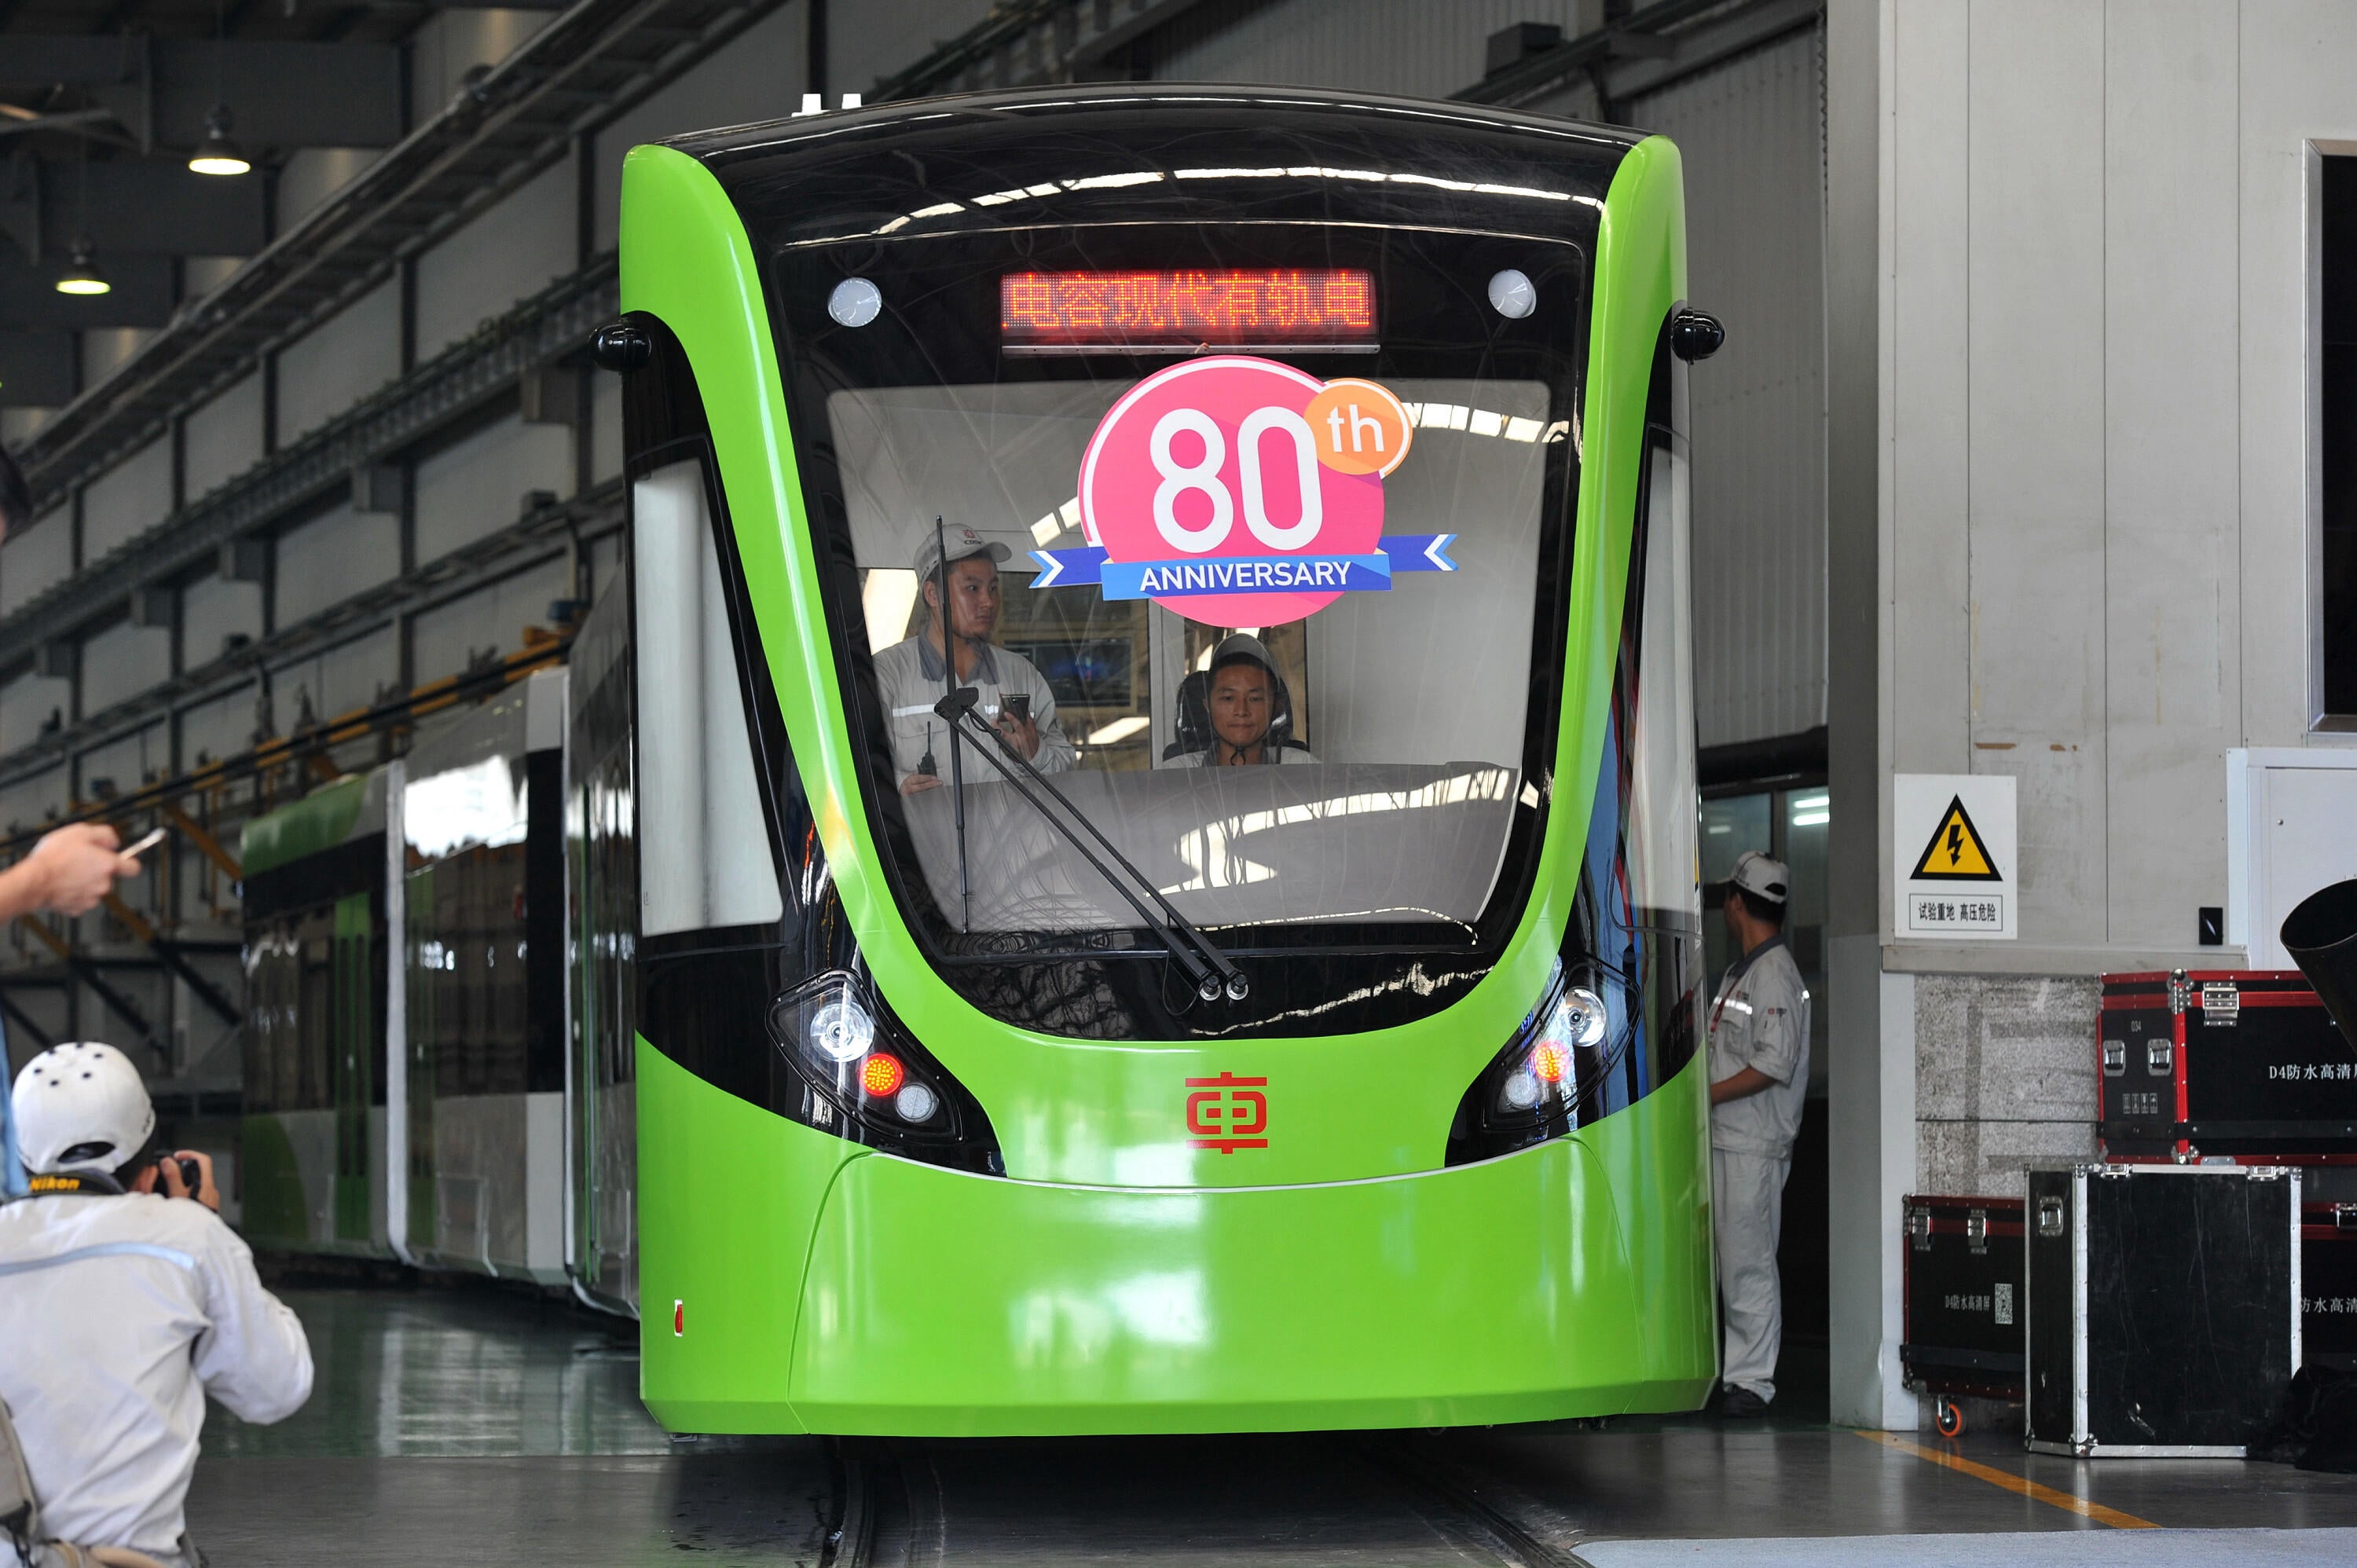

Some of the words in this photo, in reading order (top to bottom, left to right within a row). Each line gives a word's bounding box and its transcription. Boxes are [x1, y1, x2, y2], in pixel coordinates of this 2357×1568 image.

[1010, 273, 1369, 328] 电容现代有轨电
[1149, 405, 1323, 554] 80
[1326, 404, 1385, 453] th
[1139, 561, 1351, 592] ANNIVERSARY
[1919, 902, 1955, 921] 试验重地
[1960, 902, 1996, 921] 高压危险
[2269, 1063, 2357, 1080] D4防水高清
[29, 1175, 80, 1192] Nikon
